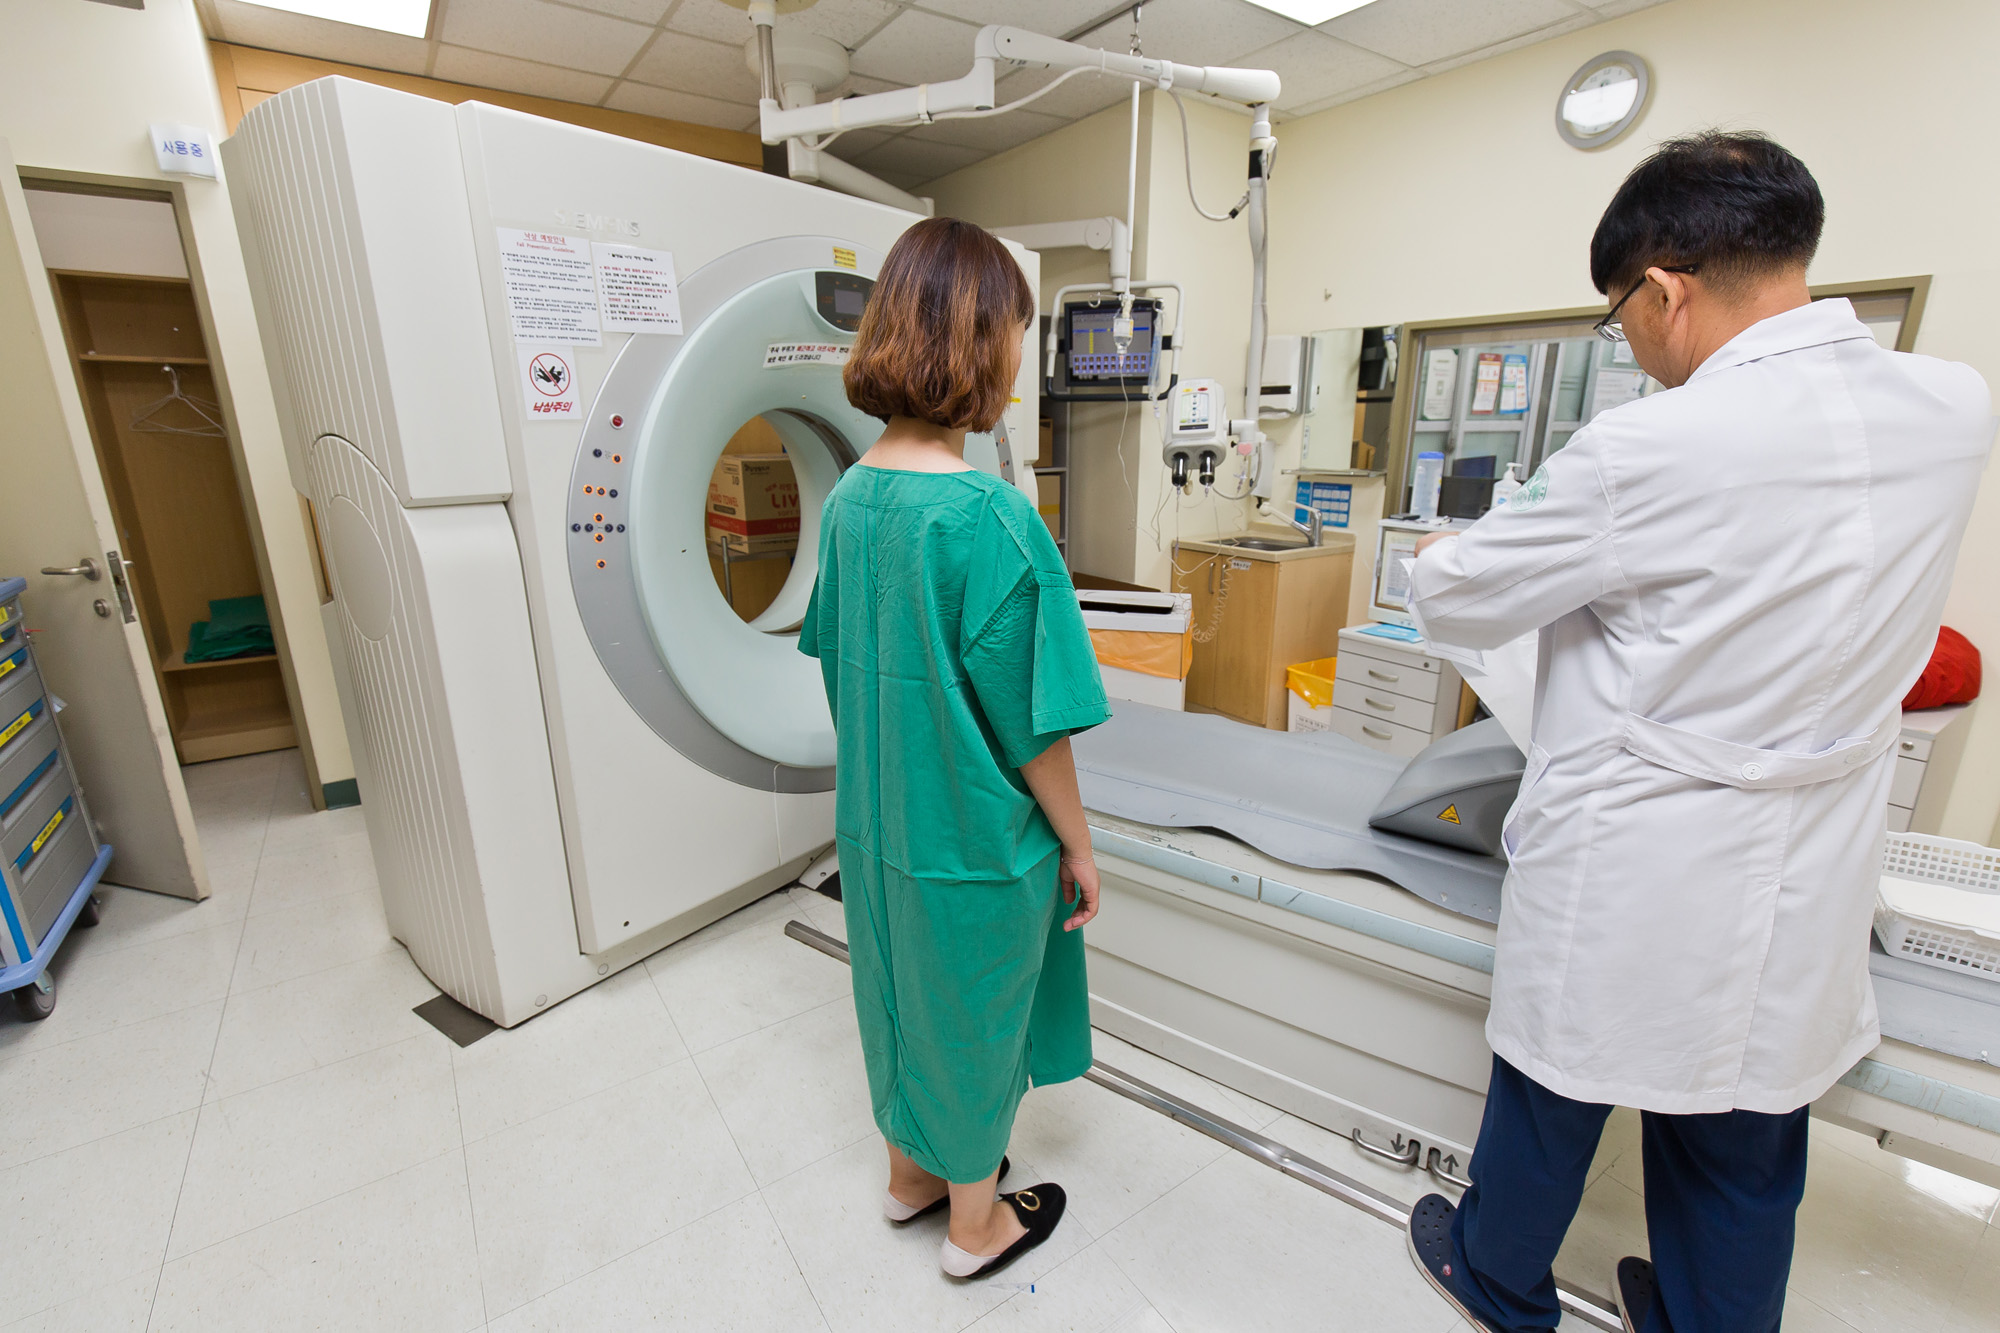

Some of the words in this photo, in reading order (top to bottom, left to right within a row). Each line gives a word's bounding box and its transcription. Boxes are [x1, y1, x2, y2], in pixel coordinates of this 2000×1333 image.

[163, 140, 203, 157] 사용중
[554, 209, 640, 237] SEMNS
[533, 401, 573, 413] 낙상주의
